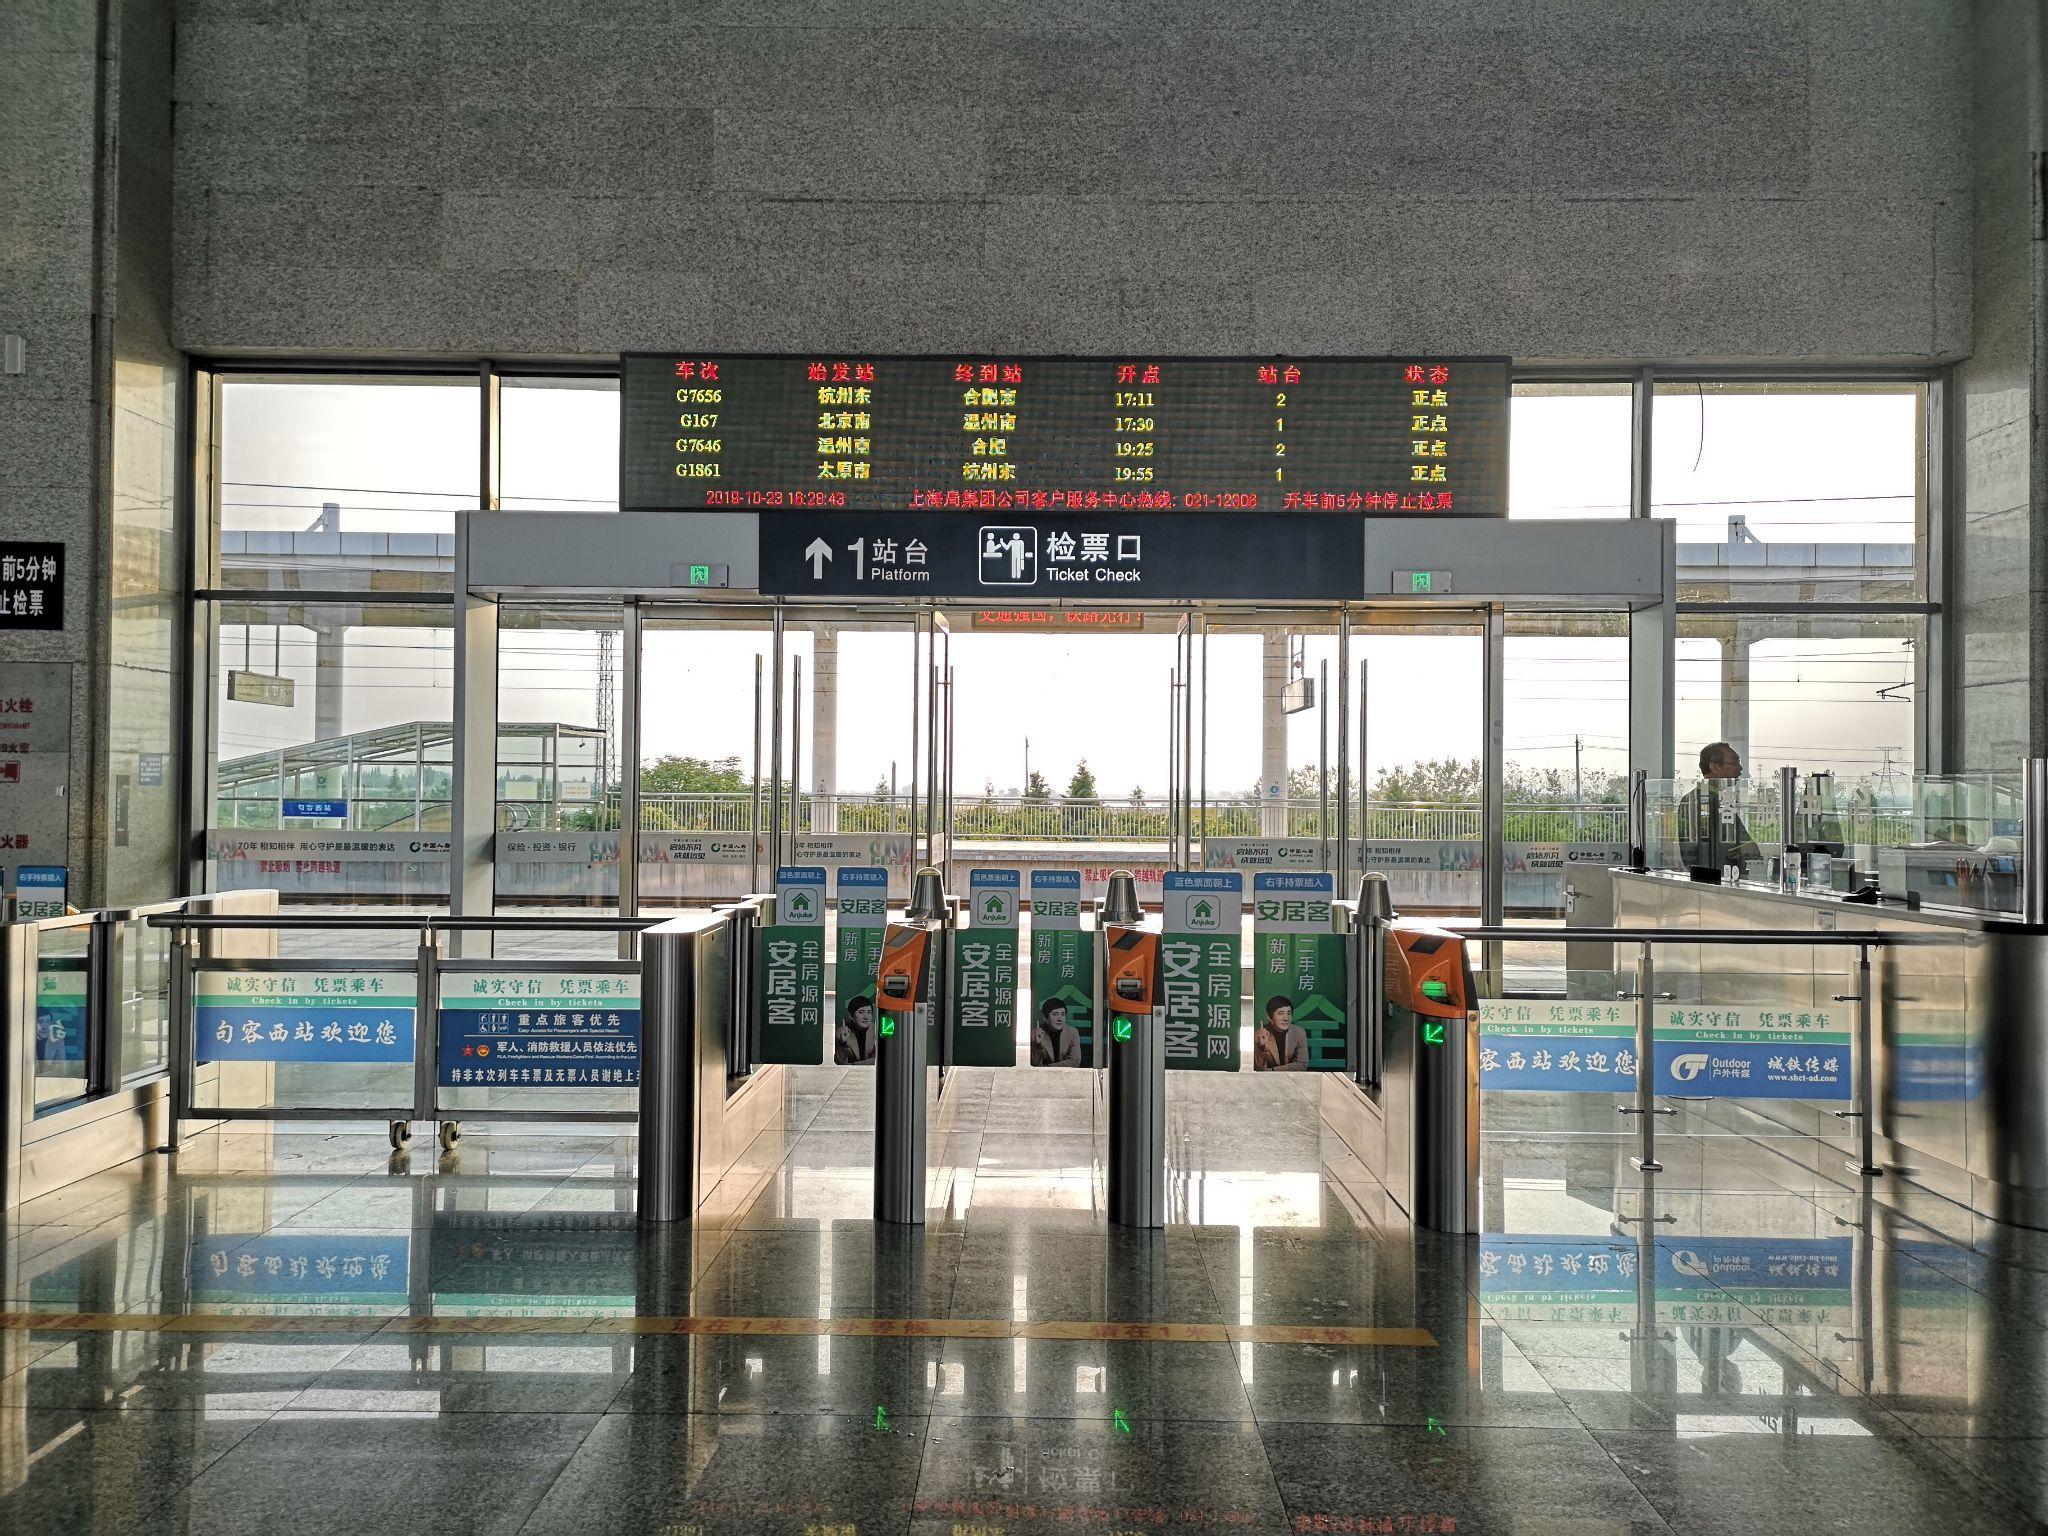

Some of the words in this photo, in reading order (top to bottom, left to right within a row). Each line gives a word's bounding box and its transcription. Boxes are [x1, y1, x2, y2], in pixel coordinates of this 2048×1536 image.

[676, 361, 719, 381] 车次
[808, 363, 874, 381] 始发站
[955, 364, 1023, 383] 终到站
[1118, 365, 1160, 384] 开点
[1258, 365, 1300, 384] 站台
[1405, 365, 1449, 384] 状态
[676, 388, 722, 404] G7656
[818, 387, 871, 404] 杭州东
[963, 388, 1017, 406] 合肥南
[1115, 392, 1155, 407] 17:11
[1276, 393, 1286, 407] 2
[1411, 389, 1448, 407] 正点
[680, 414, 719, 428] G167
[818, 412, 871, 429] 北京南
[963, 413, 1017, 431] 温州南
[1115, 417, 1154, 433] 17:30
[1276, 418, 1284, 432] 1
[1411, 415, 1448, 432] 正点
[676, 439, 721, 453] G7646
[818, 437, 871, 454] 温州南
[972, 438, 1006, 455] 合肥
[1115, 443, 1154, 457] 19:25
[1275, 443, 1286, 457] 2
[1411, 440, 1448, 457] 正点
[676, 463, 721, 478] G1861
[818, 461, 871, 479] 太原南
[963, 463, 1016, 480] 杭州东
[1115, 467, 1154, 482] 19:55
[1275, 468, 1283, 482] 1
[1411, 465, 1447, 482] 正点
[1046, 532, 1142, 562] 检票口
[2, 555, 56, 582] 前5分钟
[848, 537, 864, 580] 1
[872, 538, 928, 564] 站台
[871, 568, 930, 582] Platform
[1046, 568, 1089, 582] Ticket
[1096, 568, 1141, 582] Check
[1174, 877, 1232, 888] 蓝色票面朝上
[1265, 878, 1324, 888] 右手持票插入
[18, 900, 64, 916] 安居客
[841, 899, 885, 914] 安居客
[1033, 901, 1078, 916] 安居客
[1257, 900, 1329, 922] 安居客
[844, 932, 858, 962] 新房
[1038, 934, 1051, 964] 新房
[1061, 934, 1075, 978] 二手房
[1270, 937, 1286, 974] 新房
[1298, 938, 1315, 991] 二手房
[227, 977, 296, 992] 诚实守信
[314, 977, 384, 992] 凭票乘车
[473, 979, 542, 994] 诚实守信
[560, 979, 629, 994] 凭票乘车
[767, 940, 797, 1025] 安居客
[801, 940, 819, 1025] 全房源网
[961, 942, 991, 1027] 安居客
[994, 943, 1012, 1028] 全房源网
[252, 996, 281, 1005] Check
[289, 997, 298, 1005] in
[305, 997, 315, 1006] by
[323, 997, 358, 1005] tickets
[498, 998, 527, 1007] Check
[534, 998, 544, 1007] in
[550, 998, 562, 1008] by
[568, 999, 603, 1007] tickets
[1163, 941, 1201, 1058] 安居客
[1207, 943, 1232, 1059] 全房源网
[518, 1013, 621, 1026] 重点旅客优先
[1550, 1005, 1620, 1022] 凭票乘车
[1671, 1011, 1740, 1027] 诚实守信
[1759, 1012, 1830, 1029] 凭票乘车
[216, 1019, 397, 1044] 句容西站欢迎您
[1487, 1025, 1517, 1033] Check
[1541, 1026, 1552, 1035] by
[1696, 1031, 1725, 1039] Check
[1750, 1033, 1761, 1041] by
[1768, 1033, 1804, 1041] tickets
[497, 1041, 638, 1053] 军人、消防救援人员依法优先
[1480, 1048, 1636, 1075] 容西站欢迎您
[1712, 1057, 1751, 1068] Outdoor
[1767, 1056, 1839, 1073] 城铁传媒
[1712, 1069, 1750, 1079] 户外传媒
